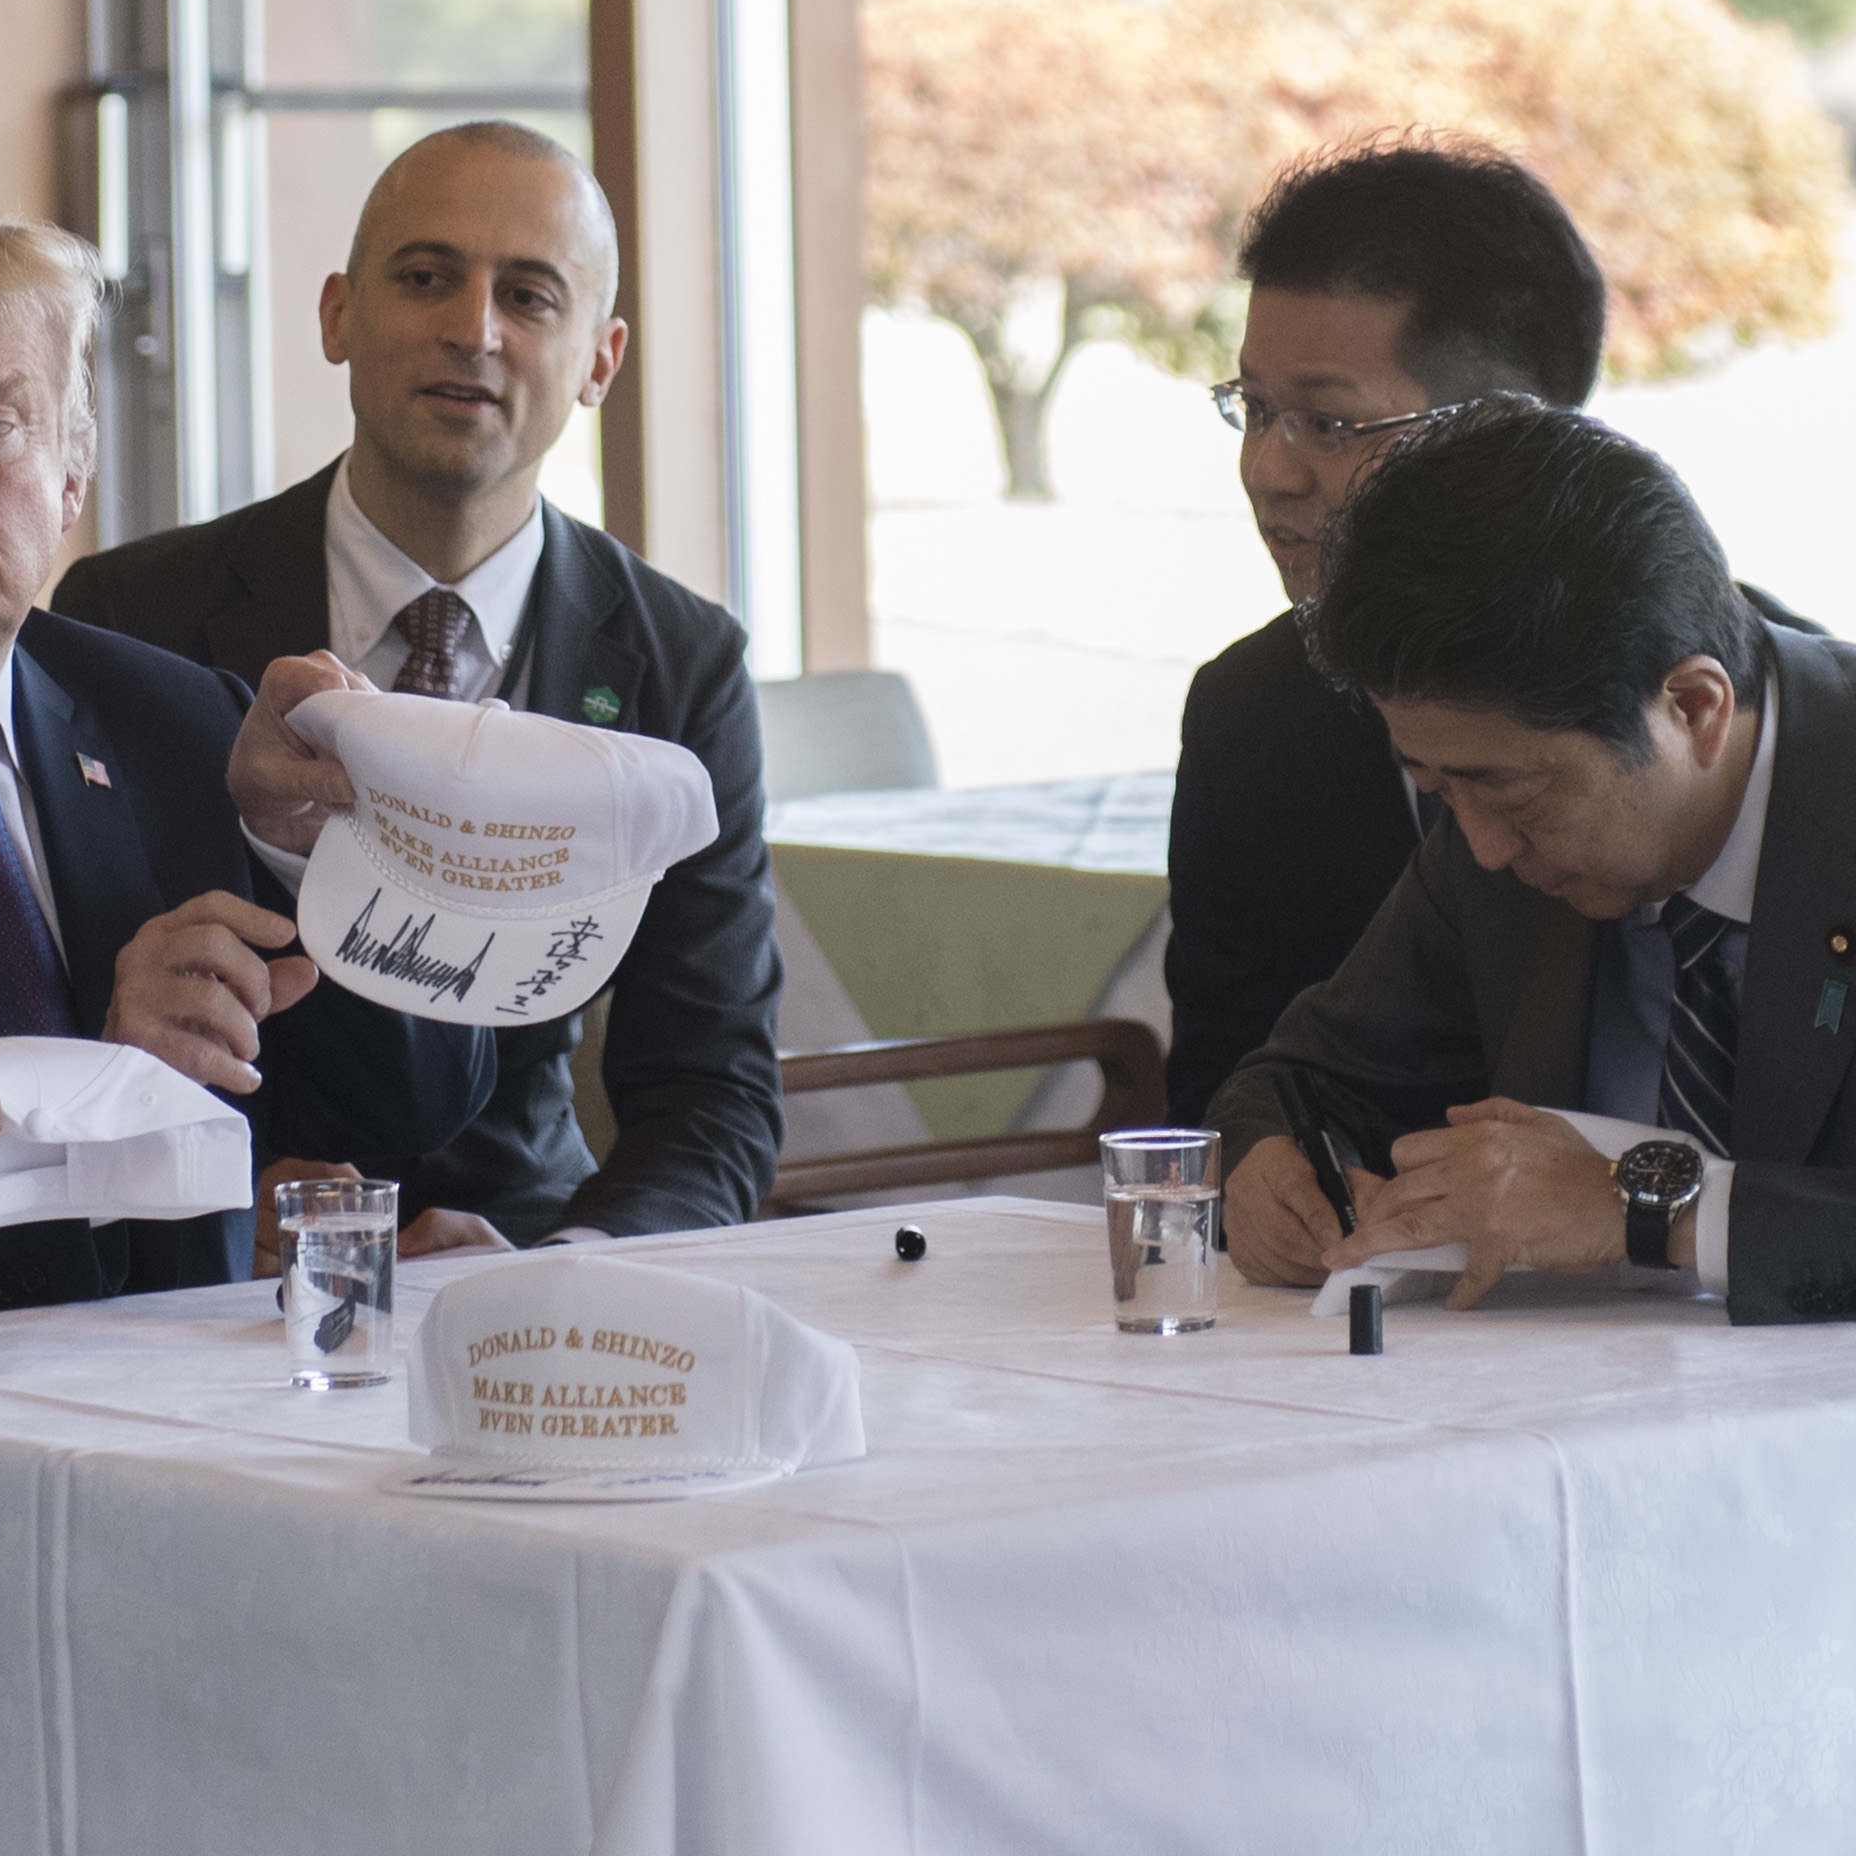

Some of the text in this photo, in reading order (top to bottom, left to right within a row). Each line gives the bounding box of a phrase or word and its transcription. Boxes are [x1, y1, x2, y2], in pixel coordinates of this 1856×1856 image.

[367, 787, 576, 841] DONALD & SHINZO
[374, 809, 569, 872] MAKE ALLIANCE
[380, 831, 564, 891] EVEN GREATER
[468, 1326, 695, 1373] DONALD & SHINZO
[473, 1376, 687, 1408] MAKE ALLIANCE
[480, 1408, 679, 1437] EVEN GREATER
